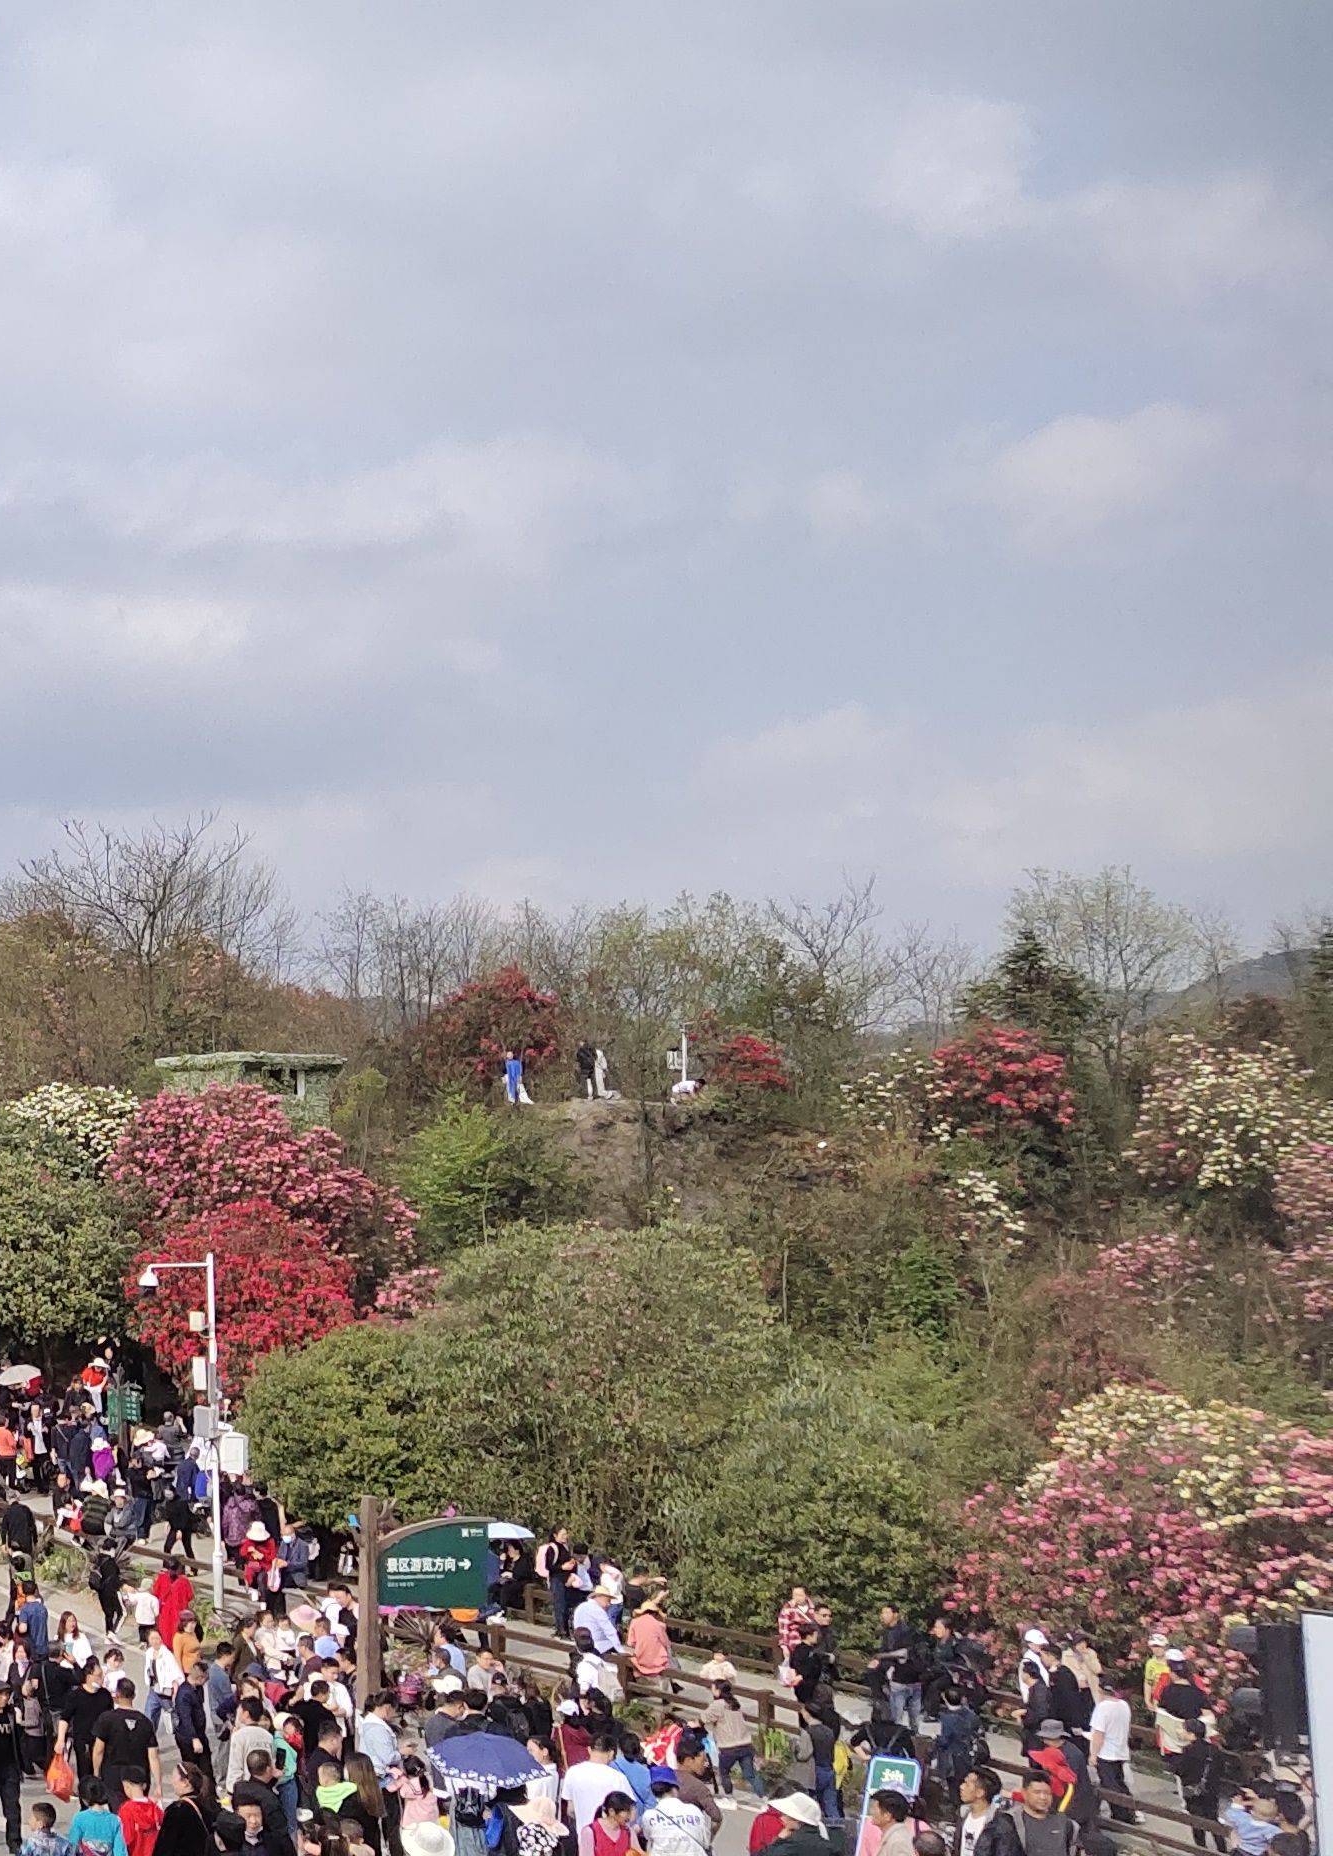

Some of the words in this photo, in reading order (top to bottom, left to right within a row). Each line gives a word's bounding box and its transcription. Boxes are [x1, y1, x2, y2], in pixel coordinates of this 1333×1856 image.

[386, 1557, 457, 1573] 景区游览方向
